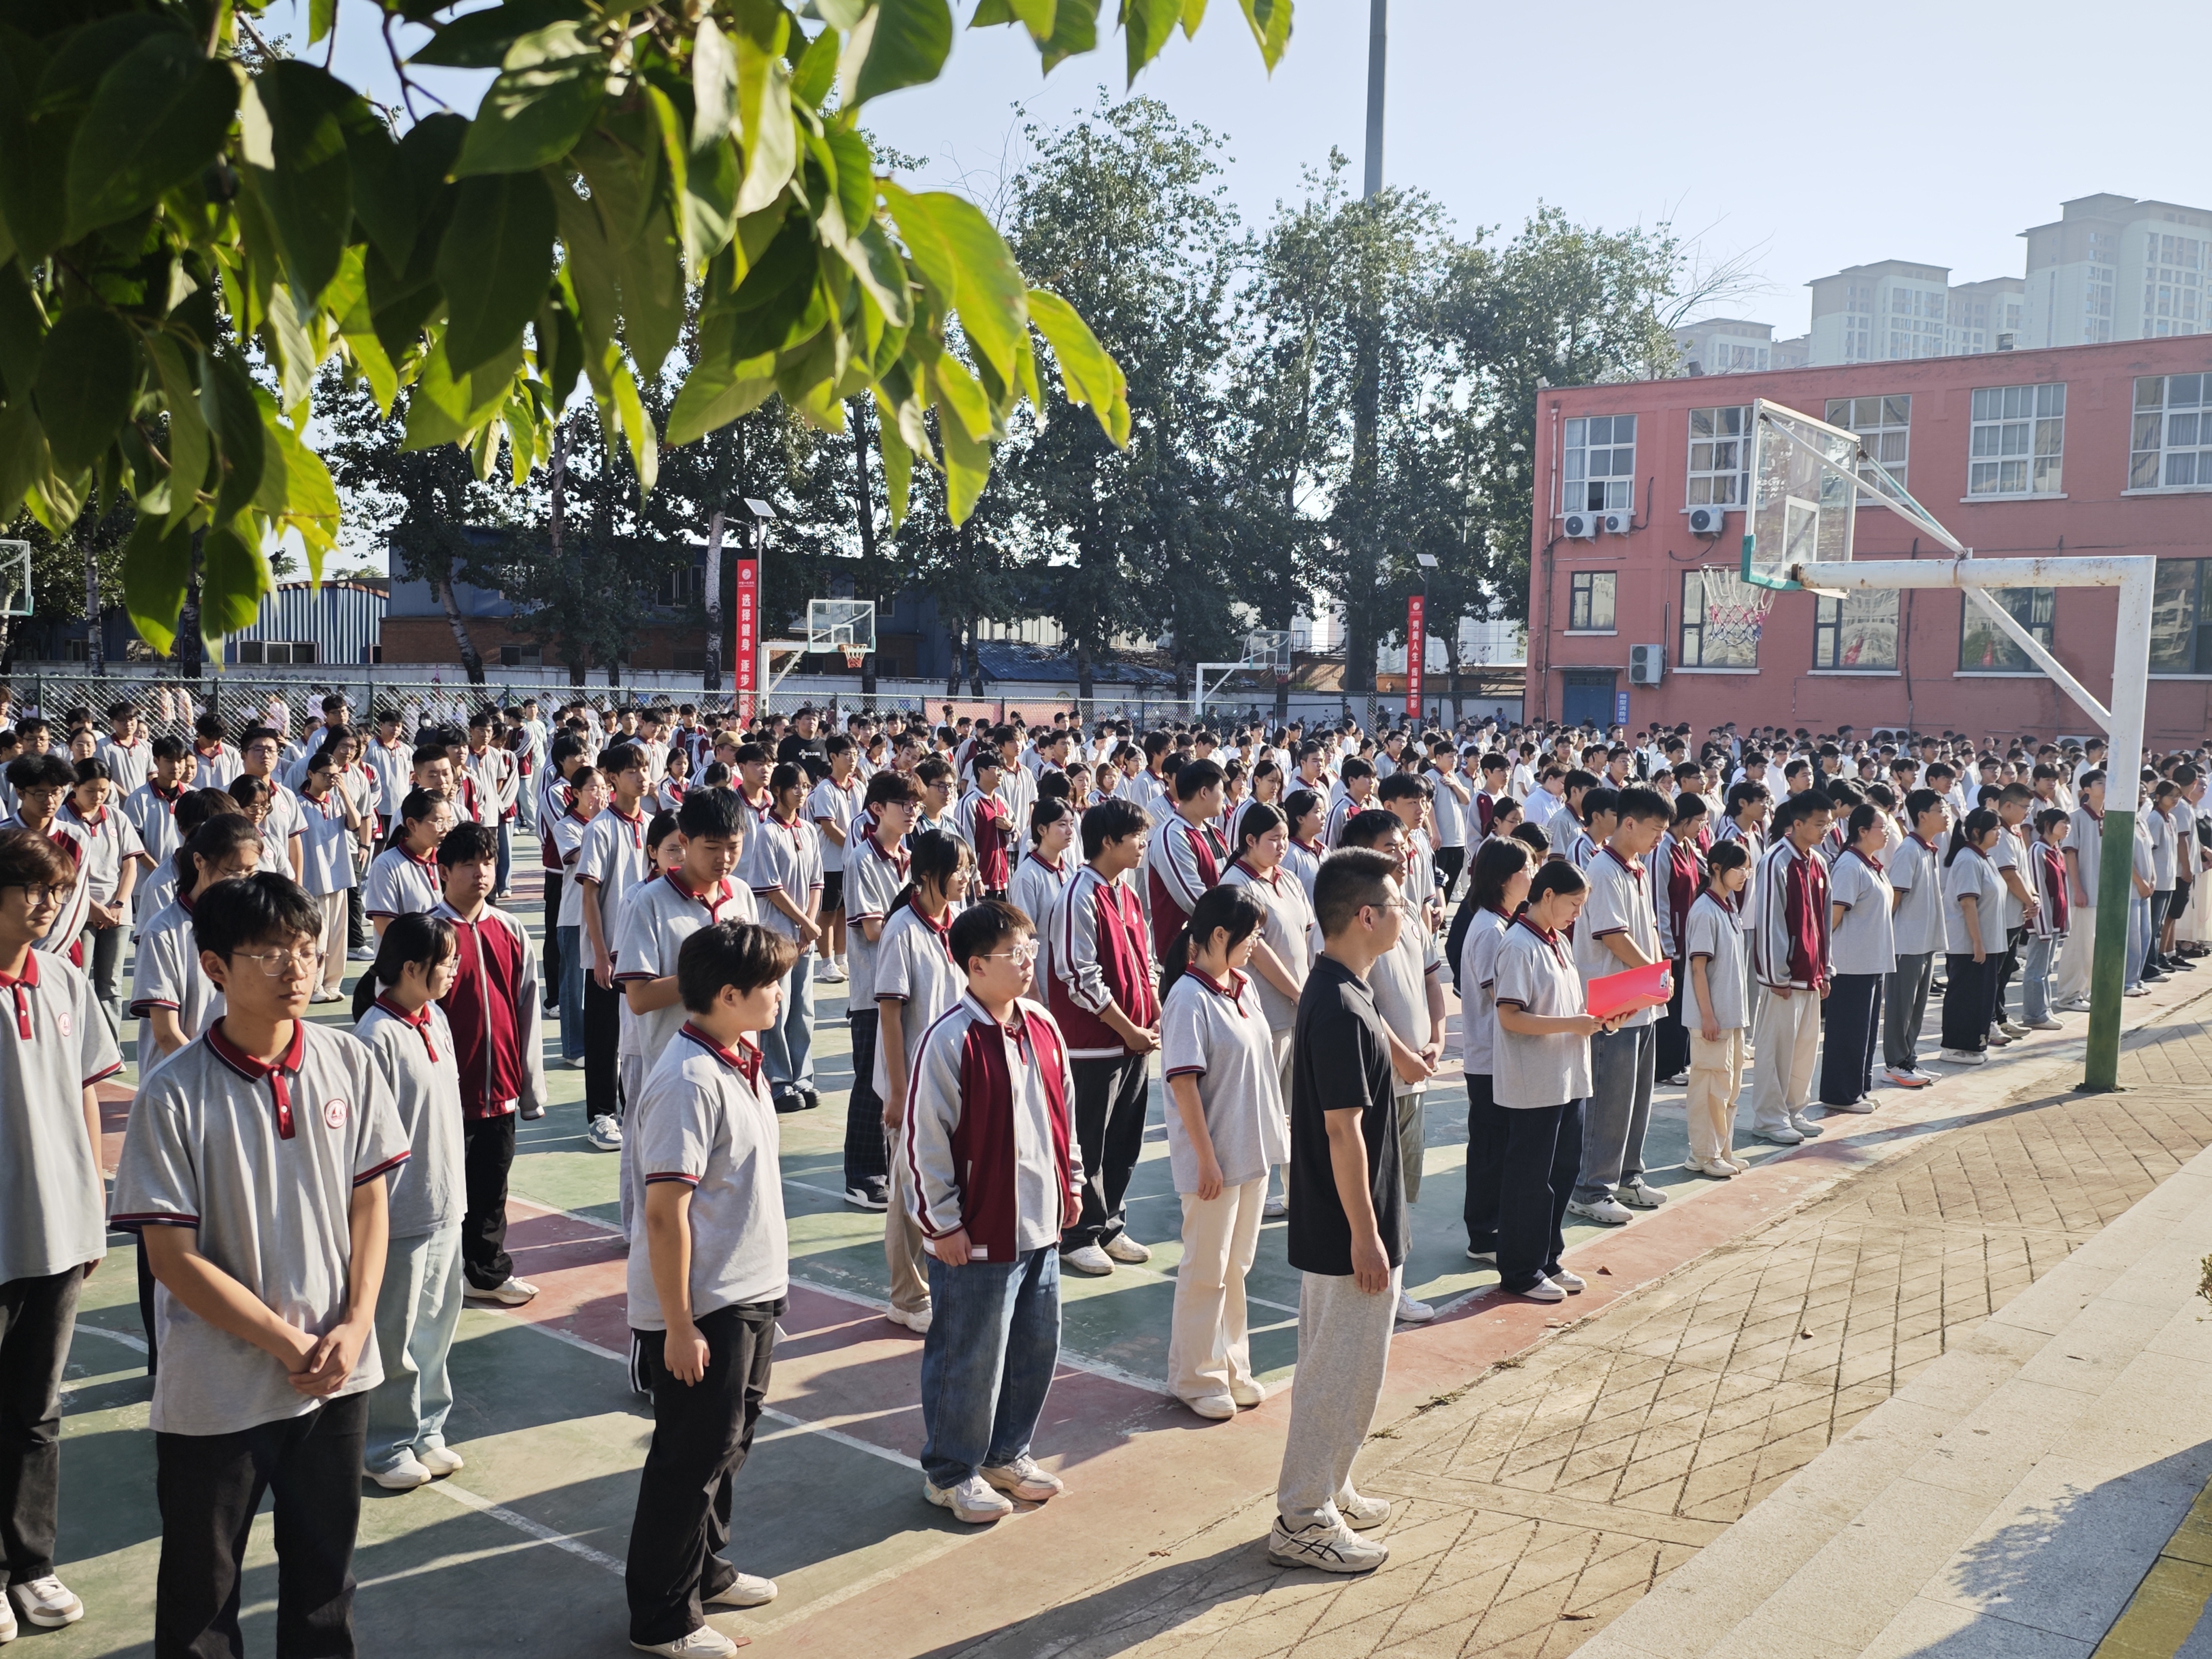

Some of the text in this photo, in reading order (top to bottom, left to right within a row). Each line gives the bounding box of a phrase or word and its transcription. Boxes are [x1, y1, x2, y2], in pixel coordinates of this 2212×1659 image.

[741, 594, 751, 651] 选择健身
[1618, 694, 1627, 723] 微型消防站
